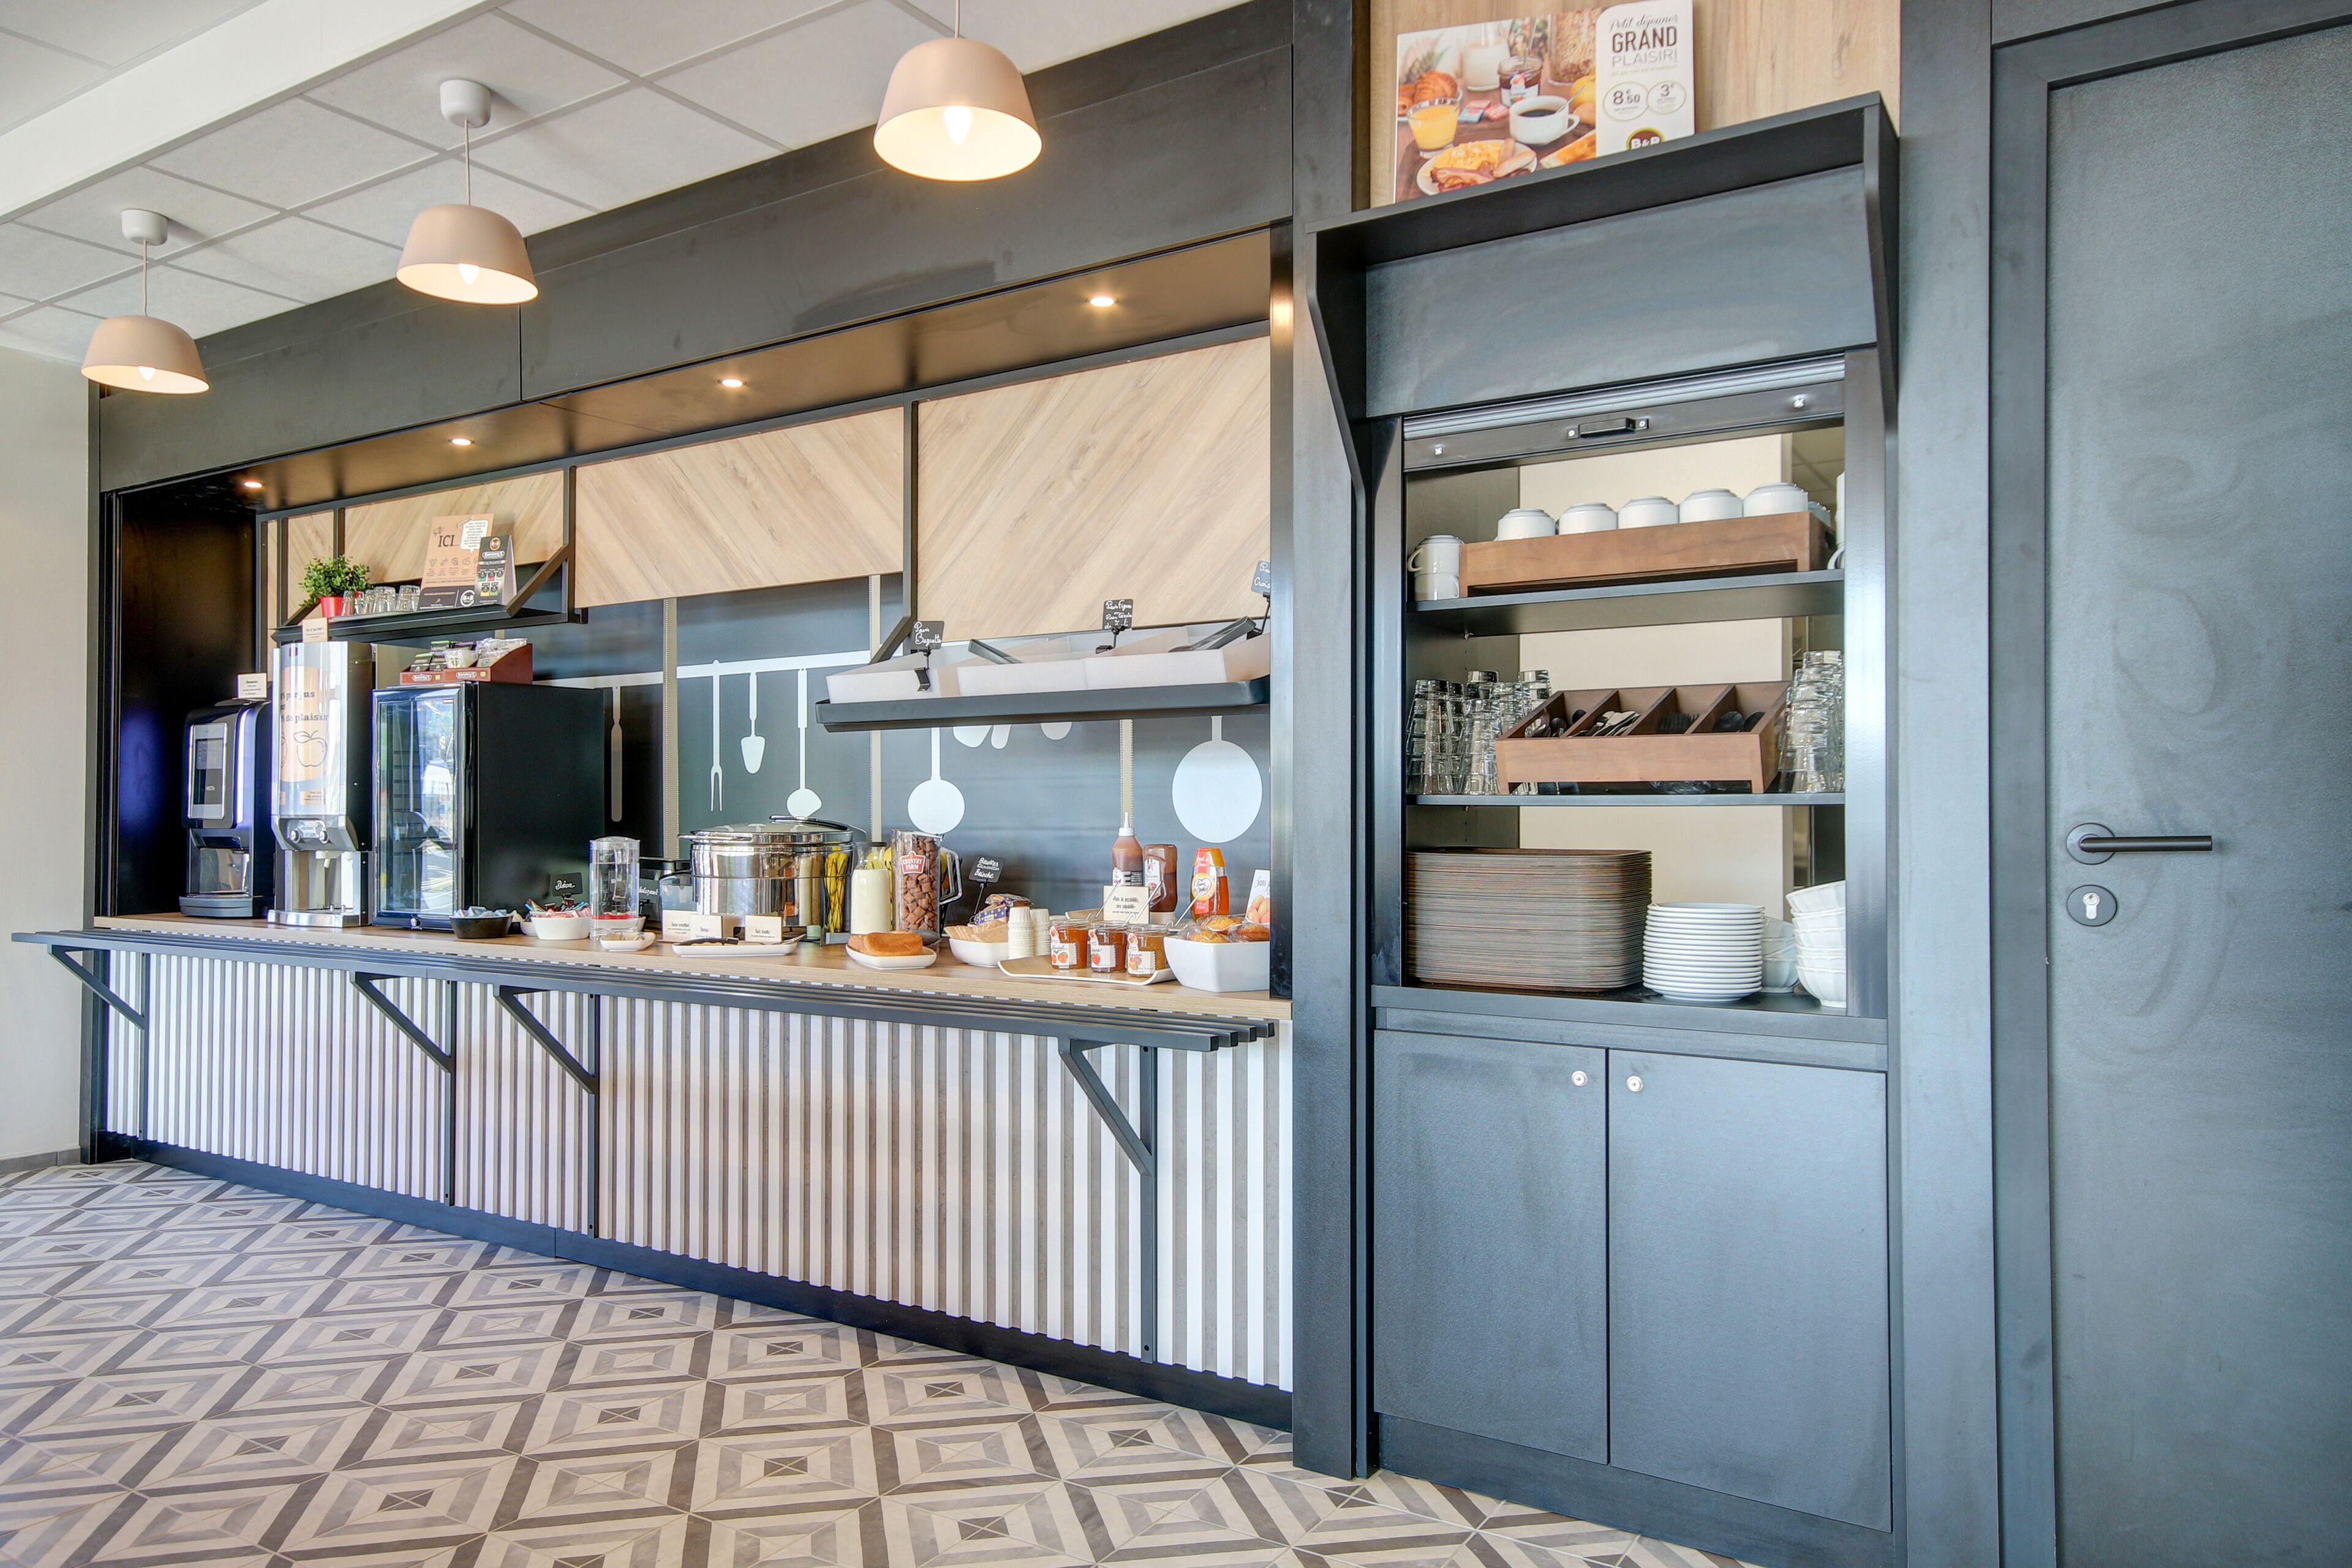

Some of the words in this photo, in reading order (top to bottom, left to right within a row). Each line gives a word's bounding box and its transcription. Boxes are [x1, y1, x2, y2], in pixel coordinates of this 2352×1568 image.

[1610, 17, 1634, 31] Petit
[1637, 13, 1678, 29] déjeuner
[1612, 26, 1677, 53] GRAND
[1612, 48, 1678, 67] PLAISIR!
[914, 621, 930, 632] Pain
[295, 713, 329, 723] plaisir
[555, 879, 576, 890] Déca
